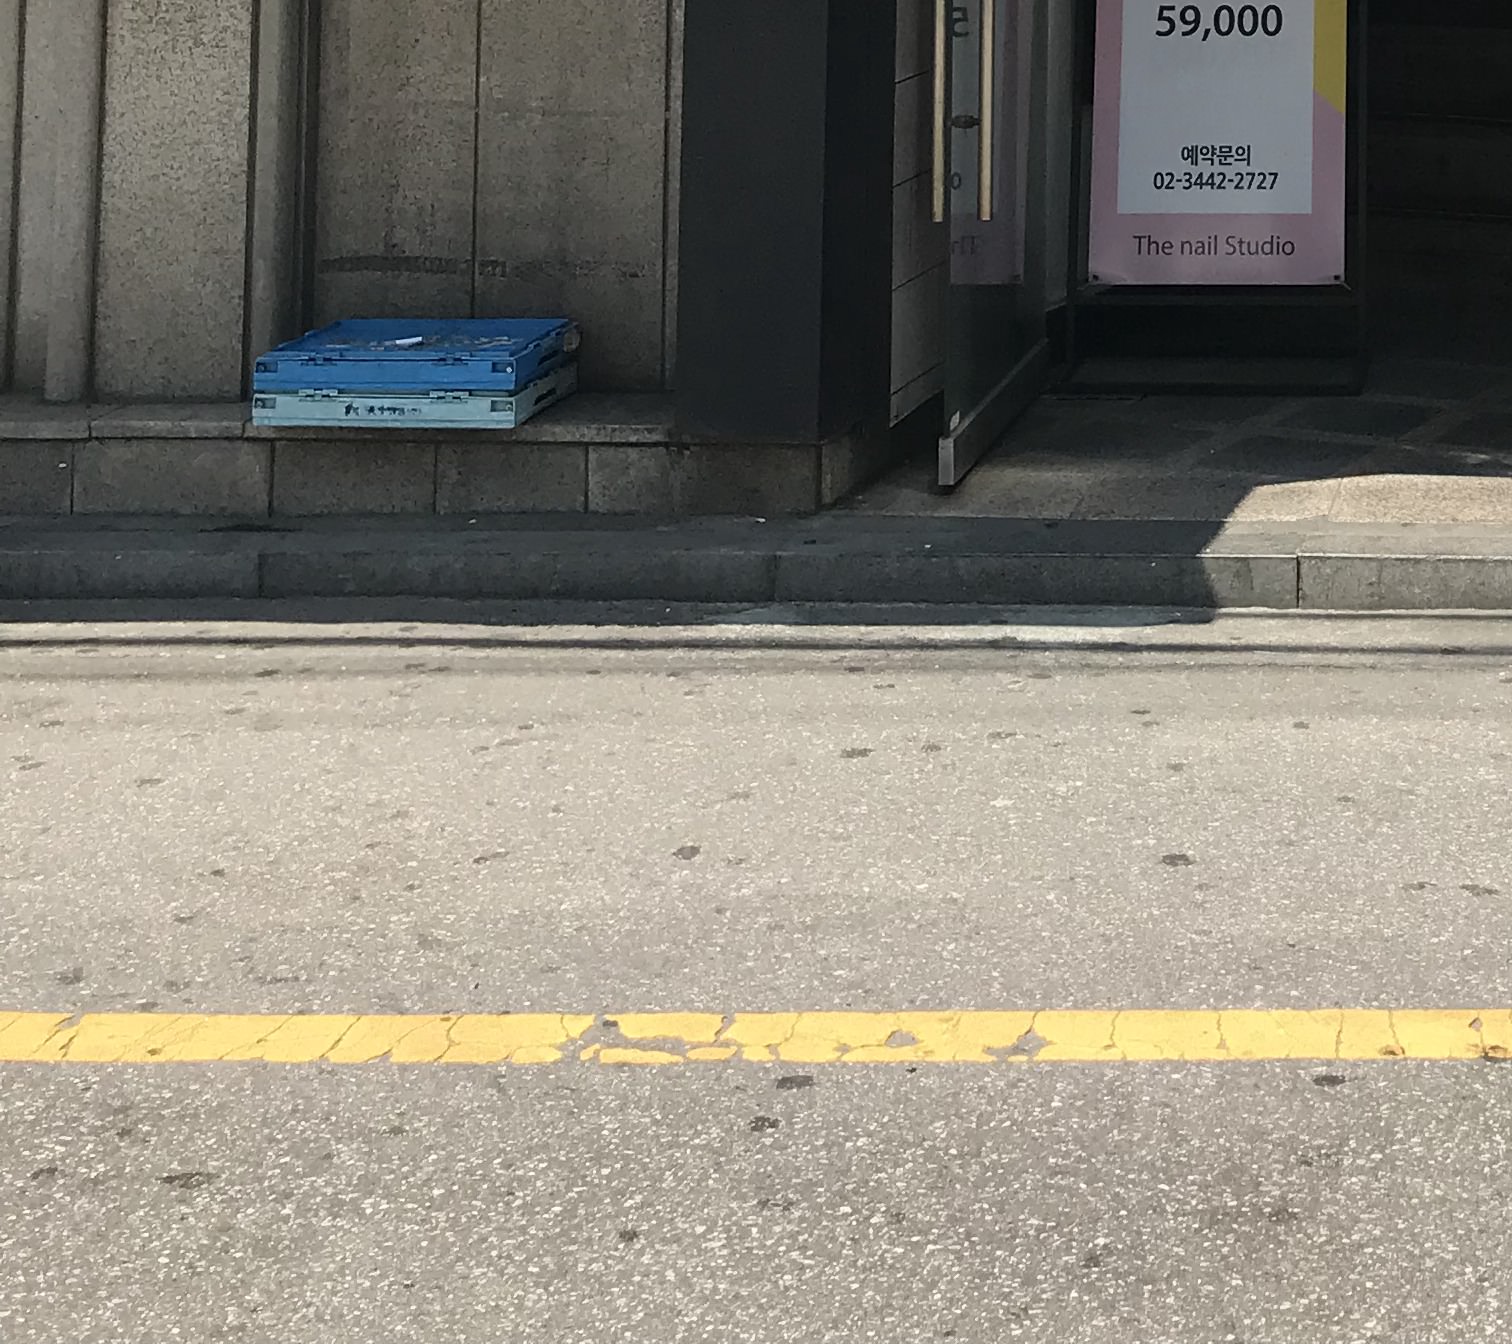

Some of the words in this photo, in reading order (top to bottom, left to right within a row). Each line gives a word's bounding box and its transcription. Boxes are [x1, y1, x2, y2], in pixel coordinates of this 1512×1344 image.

[1155, 4, 1283, 41] 59,000
[1181, 145, 1251, 167] 예약문의
[1153, 172, 1278, 191] 02-3442-2727
[1133, 235, 1174, 256] The
[1180, 235, 1218, 256] nail
[1225, 235, 1295, 256] Studio
